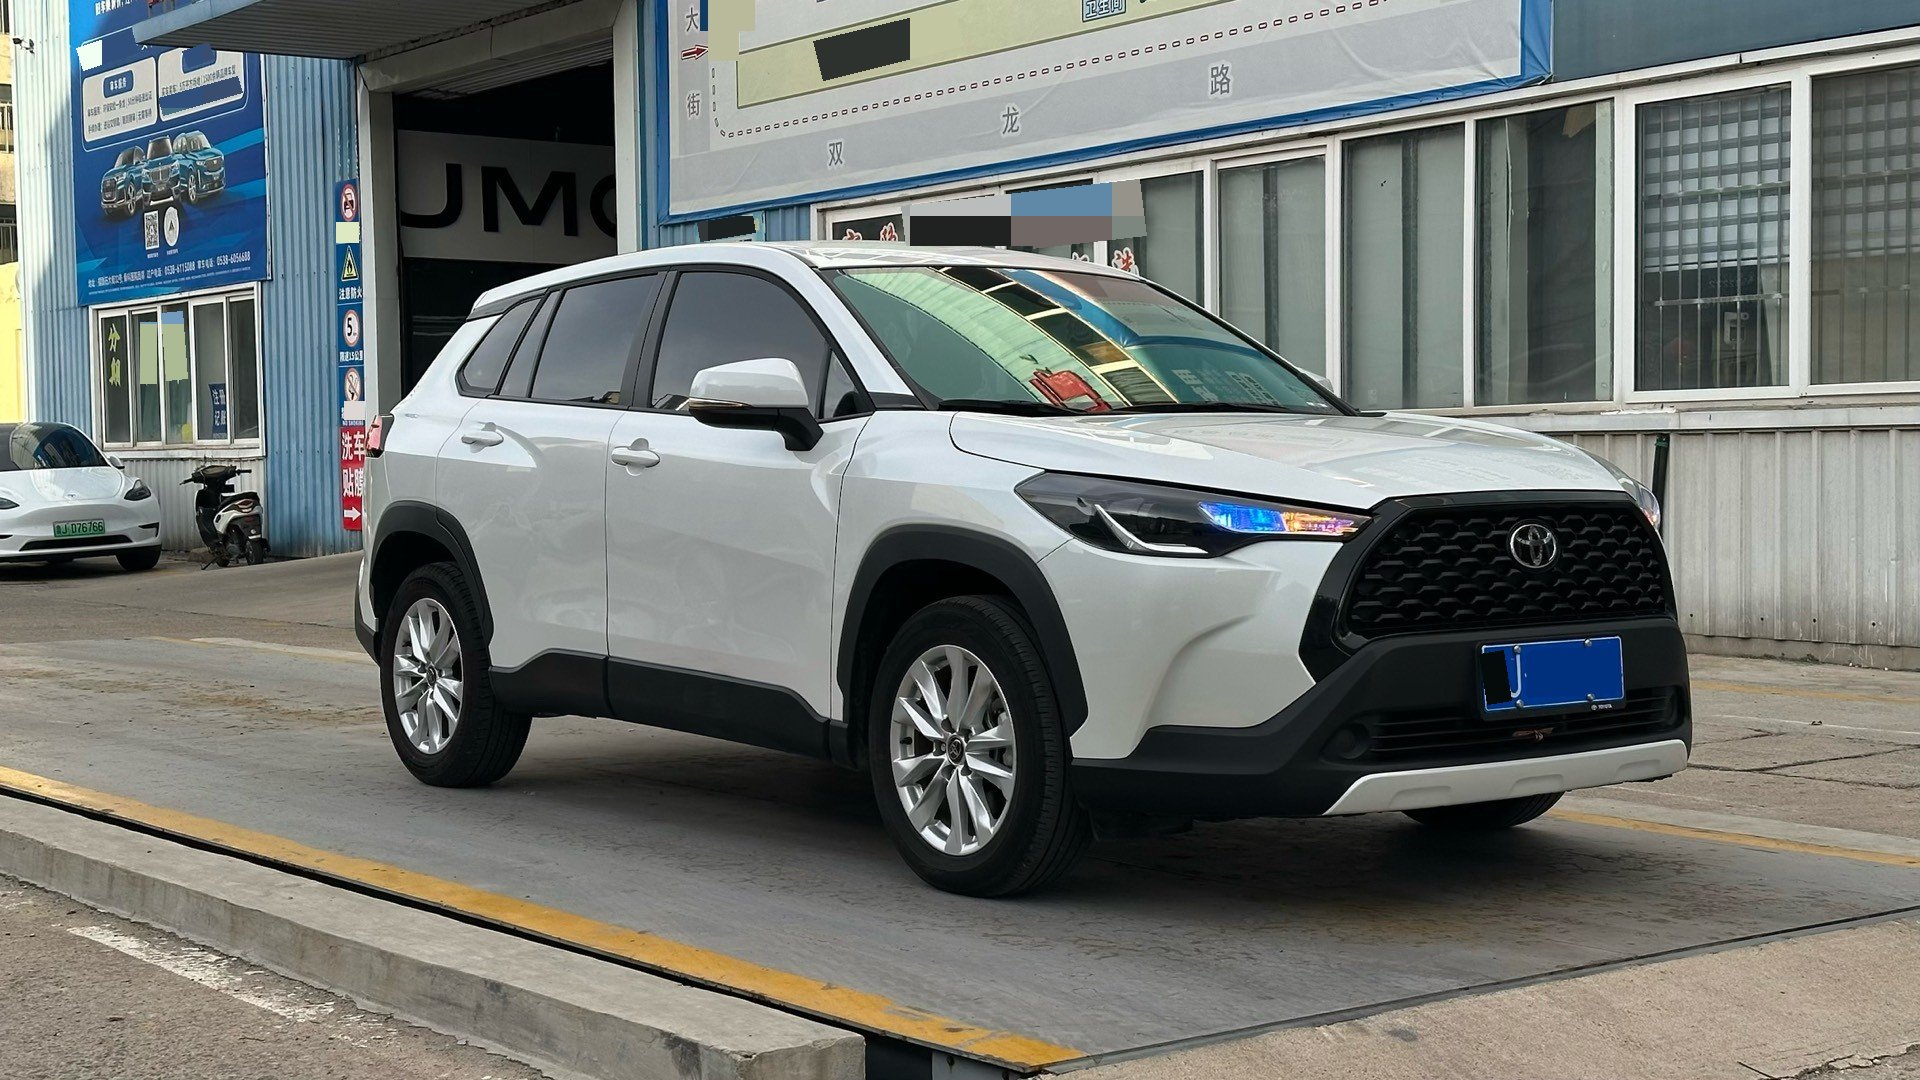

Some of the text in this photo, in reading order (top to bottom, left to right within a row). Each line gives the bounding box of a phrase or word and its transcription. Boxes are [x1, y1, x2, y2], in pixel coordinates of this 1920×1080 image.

[685, 7, 699, 32] 大
[1086, 0, 1123, 19] 卫生间
[1210, 65, 1231, 97] 路
[686, 92, 701, 118] 街
[1001, 106, 1021, 136] 龙
[827, 142, 844, 167] 双
[338, 286, 363, 300] 注意防火
[346, 317, 353, 337] 5
[342, 431, 366, 461] 洗车
